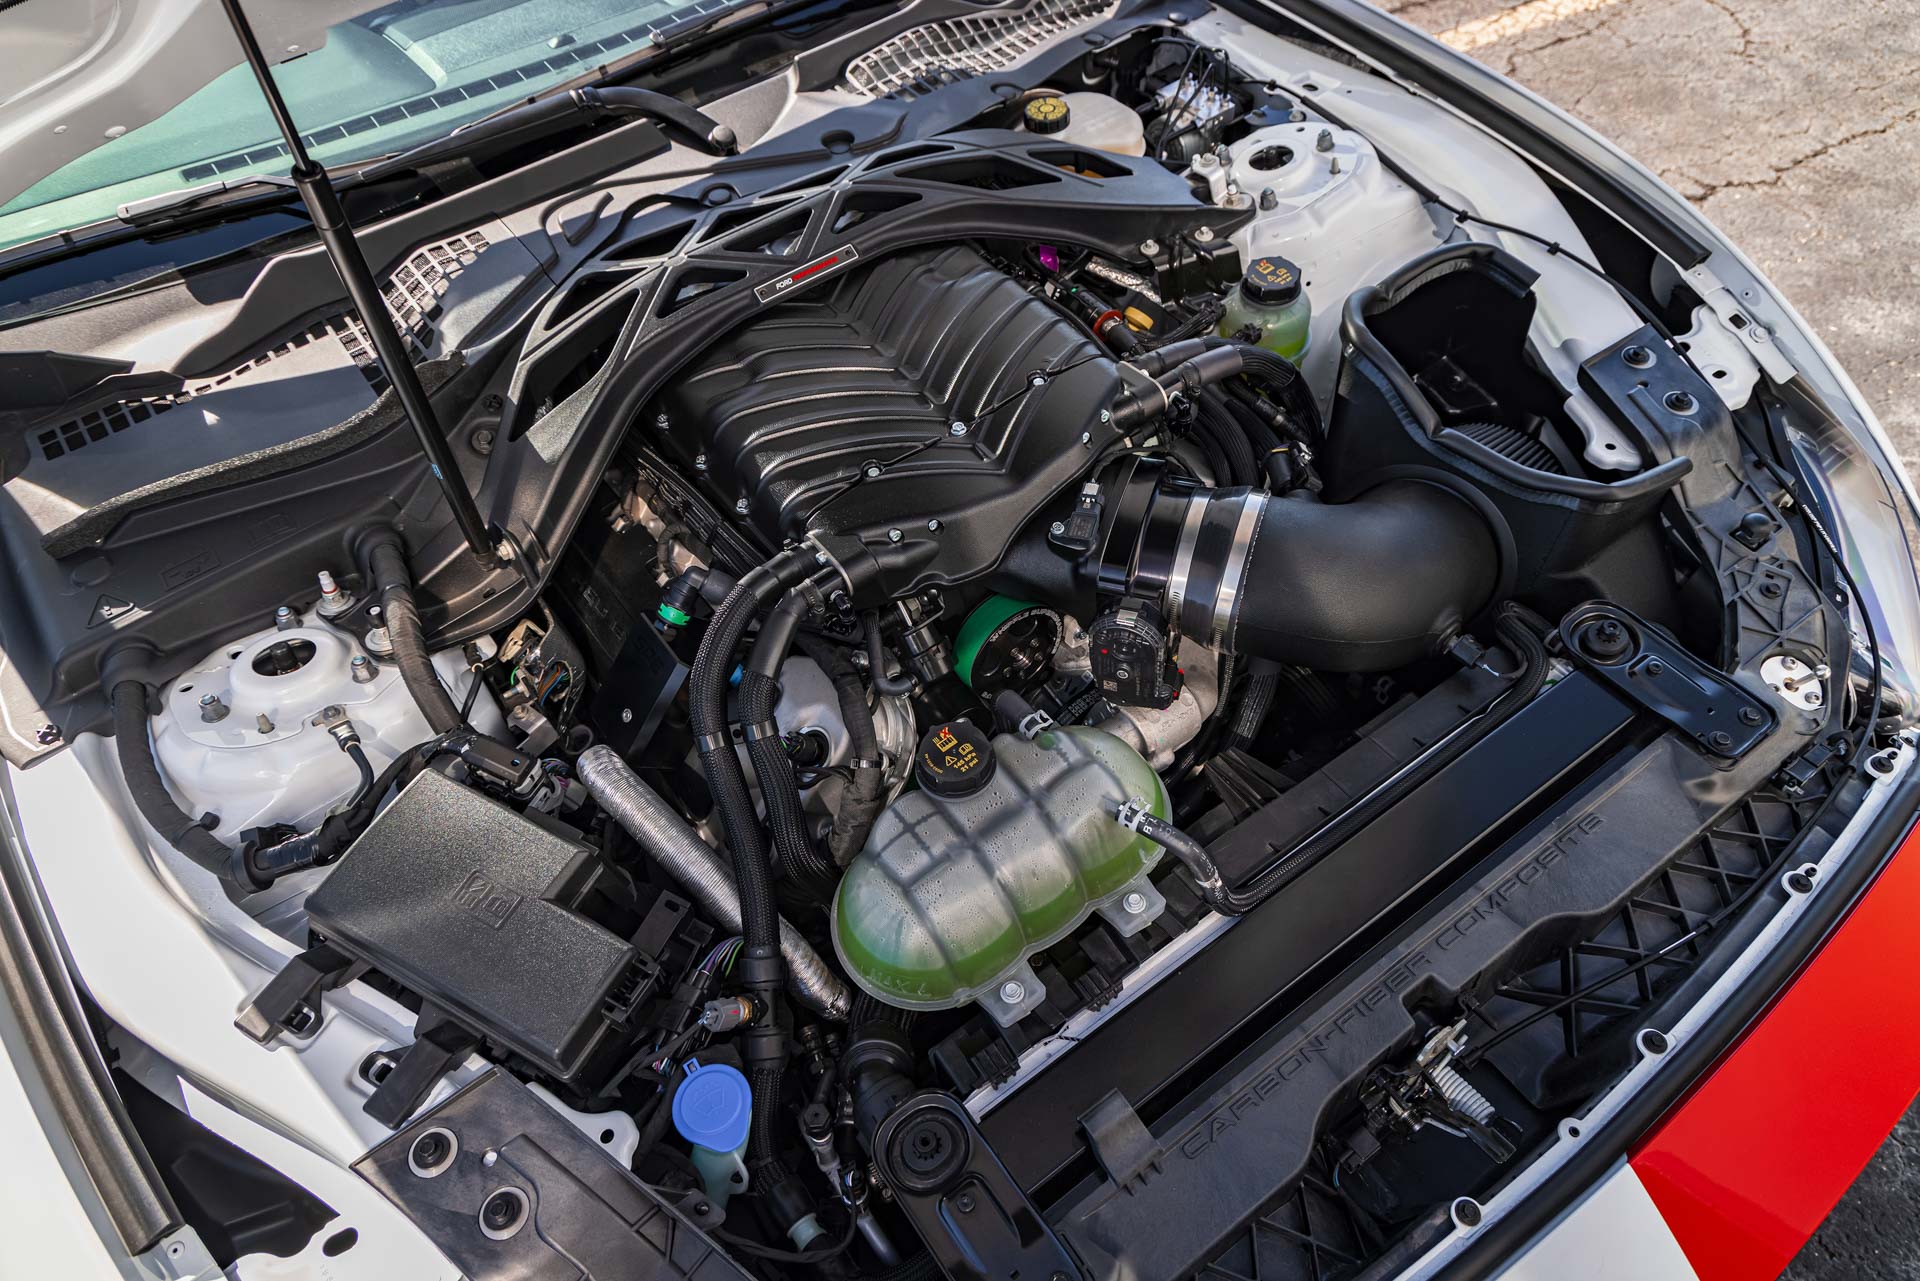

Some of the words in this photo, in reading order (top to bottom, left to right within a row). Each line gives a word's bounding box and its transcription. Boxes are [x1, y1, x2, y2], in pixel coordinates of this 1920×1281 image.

[776, 277, 792, 290] FORD
[1181, 953, 1432, 1160] CARBON-FIBER
[1435, 812, 1604, 951] COMPOSITE
